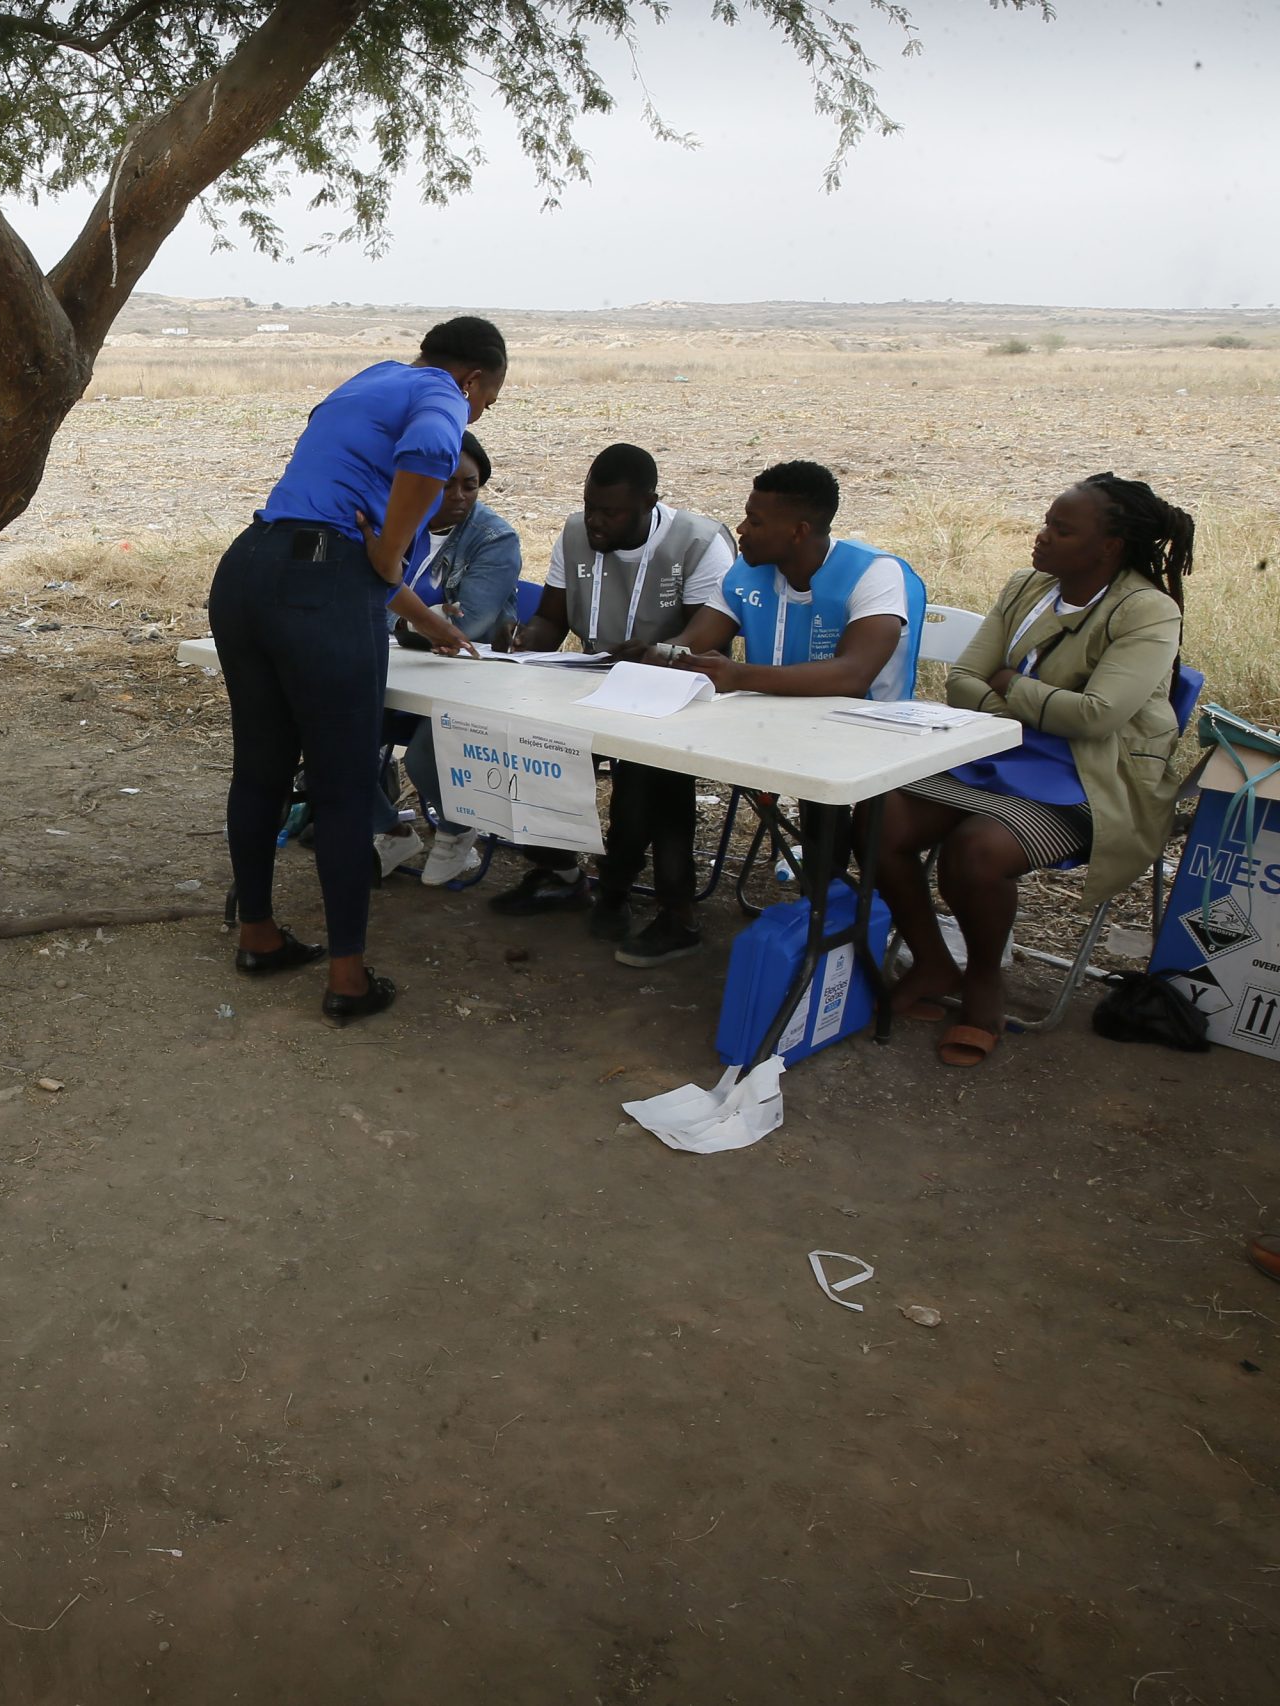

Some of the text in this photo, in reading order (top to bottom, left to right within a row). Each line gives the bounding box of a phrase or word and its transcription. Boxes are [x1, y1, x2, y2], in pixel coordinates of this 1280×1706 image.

[519, 737, 580, 757] Eleições Gerais 2022
[463, 743, 562, 779] MESA DE VOTO
[450, 767, 472, 788] Nº
[456, 806, 476, 817] LETRA
[1198, 924, 1237, 938] CRROSIVE
